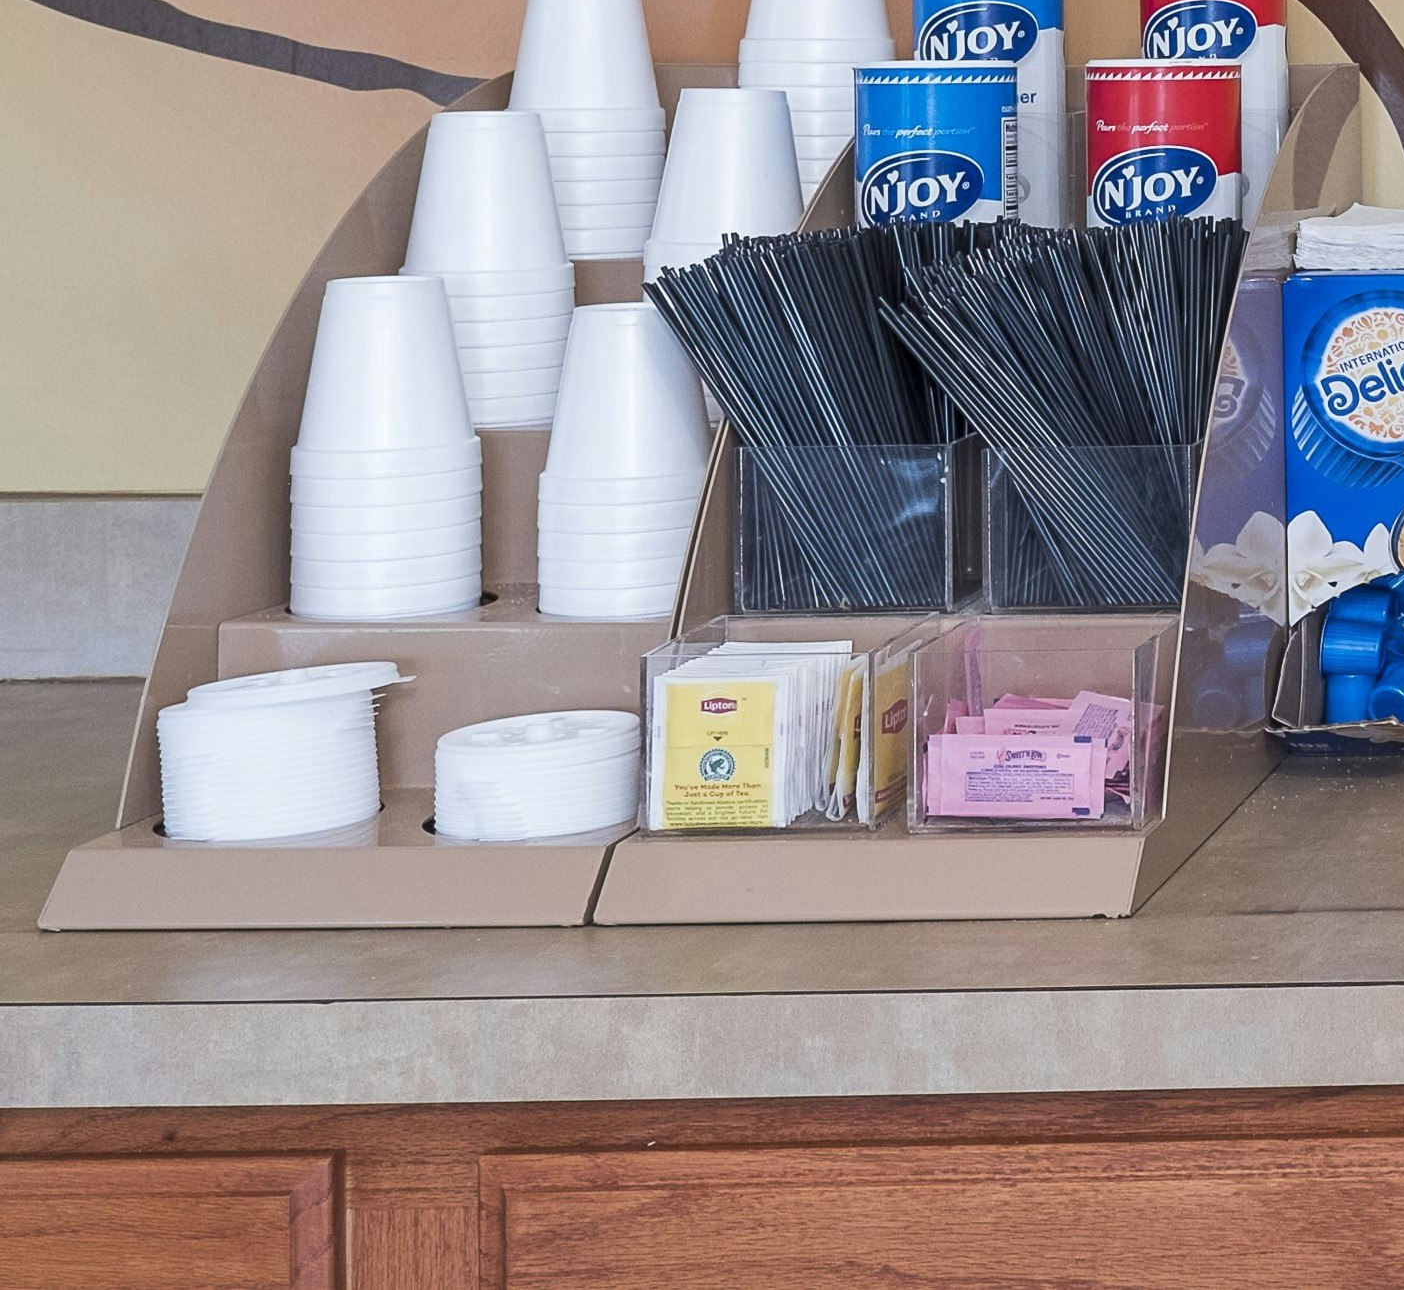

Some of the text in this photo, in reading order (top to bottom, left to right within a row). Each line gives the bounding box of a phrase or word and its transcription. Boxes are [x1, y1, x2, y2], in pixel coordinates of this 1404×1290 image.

[895, 124, 934, 139] perfect
[1131, 121, 1170, 135] perfect
[1125, 204, 1176, 219] BRAND
[703, 701, 737, 712] Lipton
[884, 705, 908, 730] Lipto
